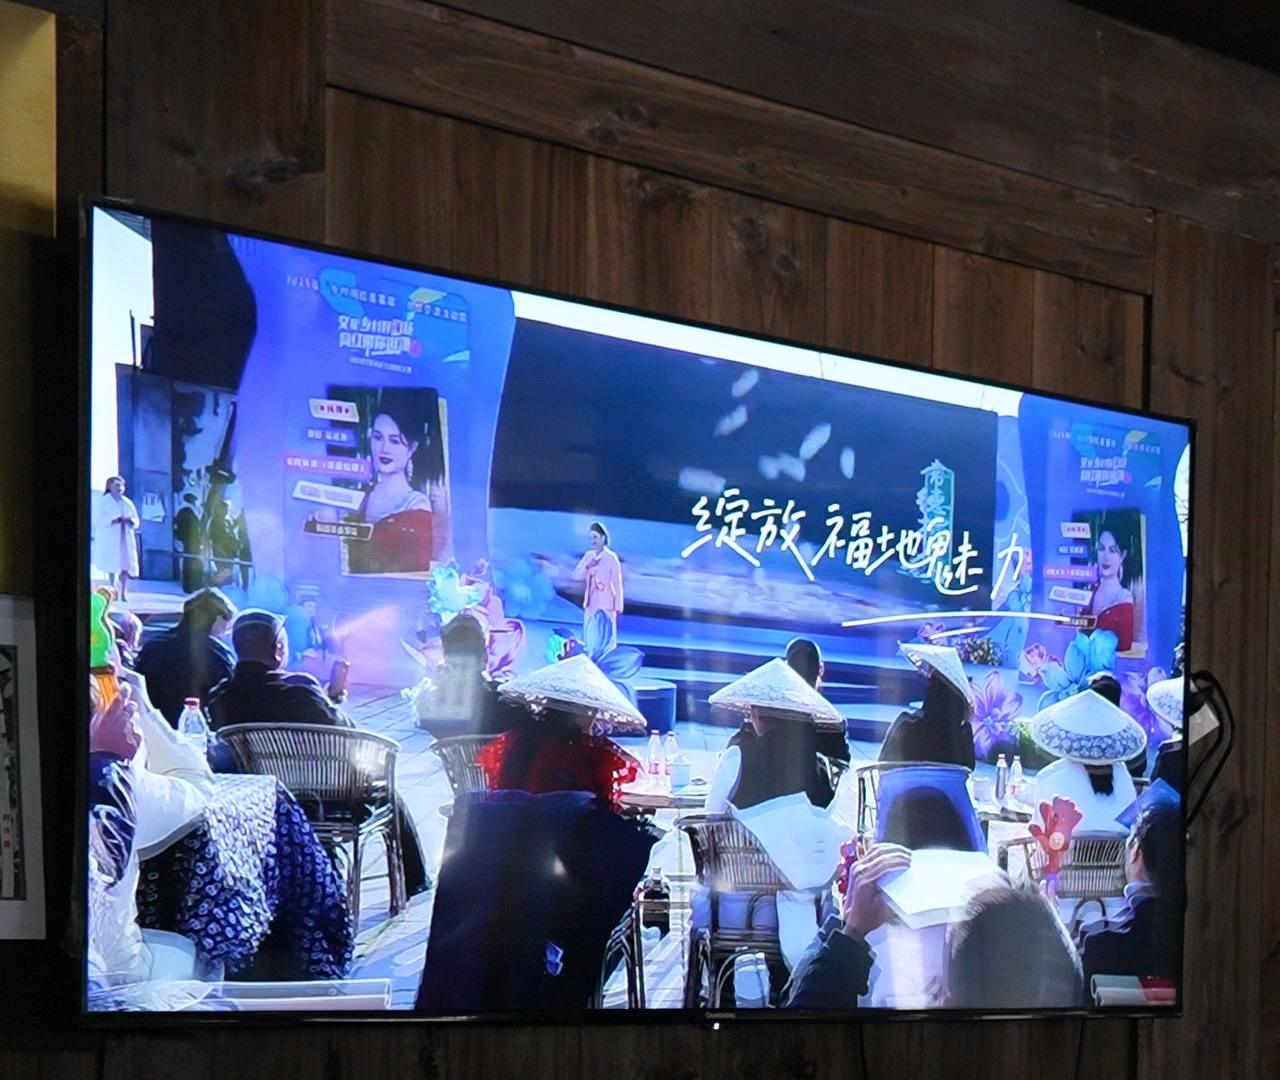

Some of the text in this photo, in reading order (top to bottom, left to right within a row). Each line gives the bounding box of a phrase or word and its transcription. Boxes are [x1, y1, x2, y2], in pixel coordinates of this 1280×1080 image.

[681, 488, 1026, 600] 绽放福地魅力
